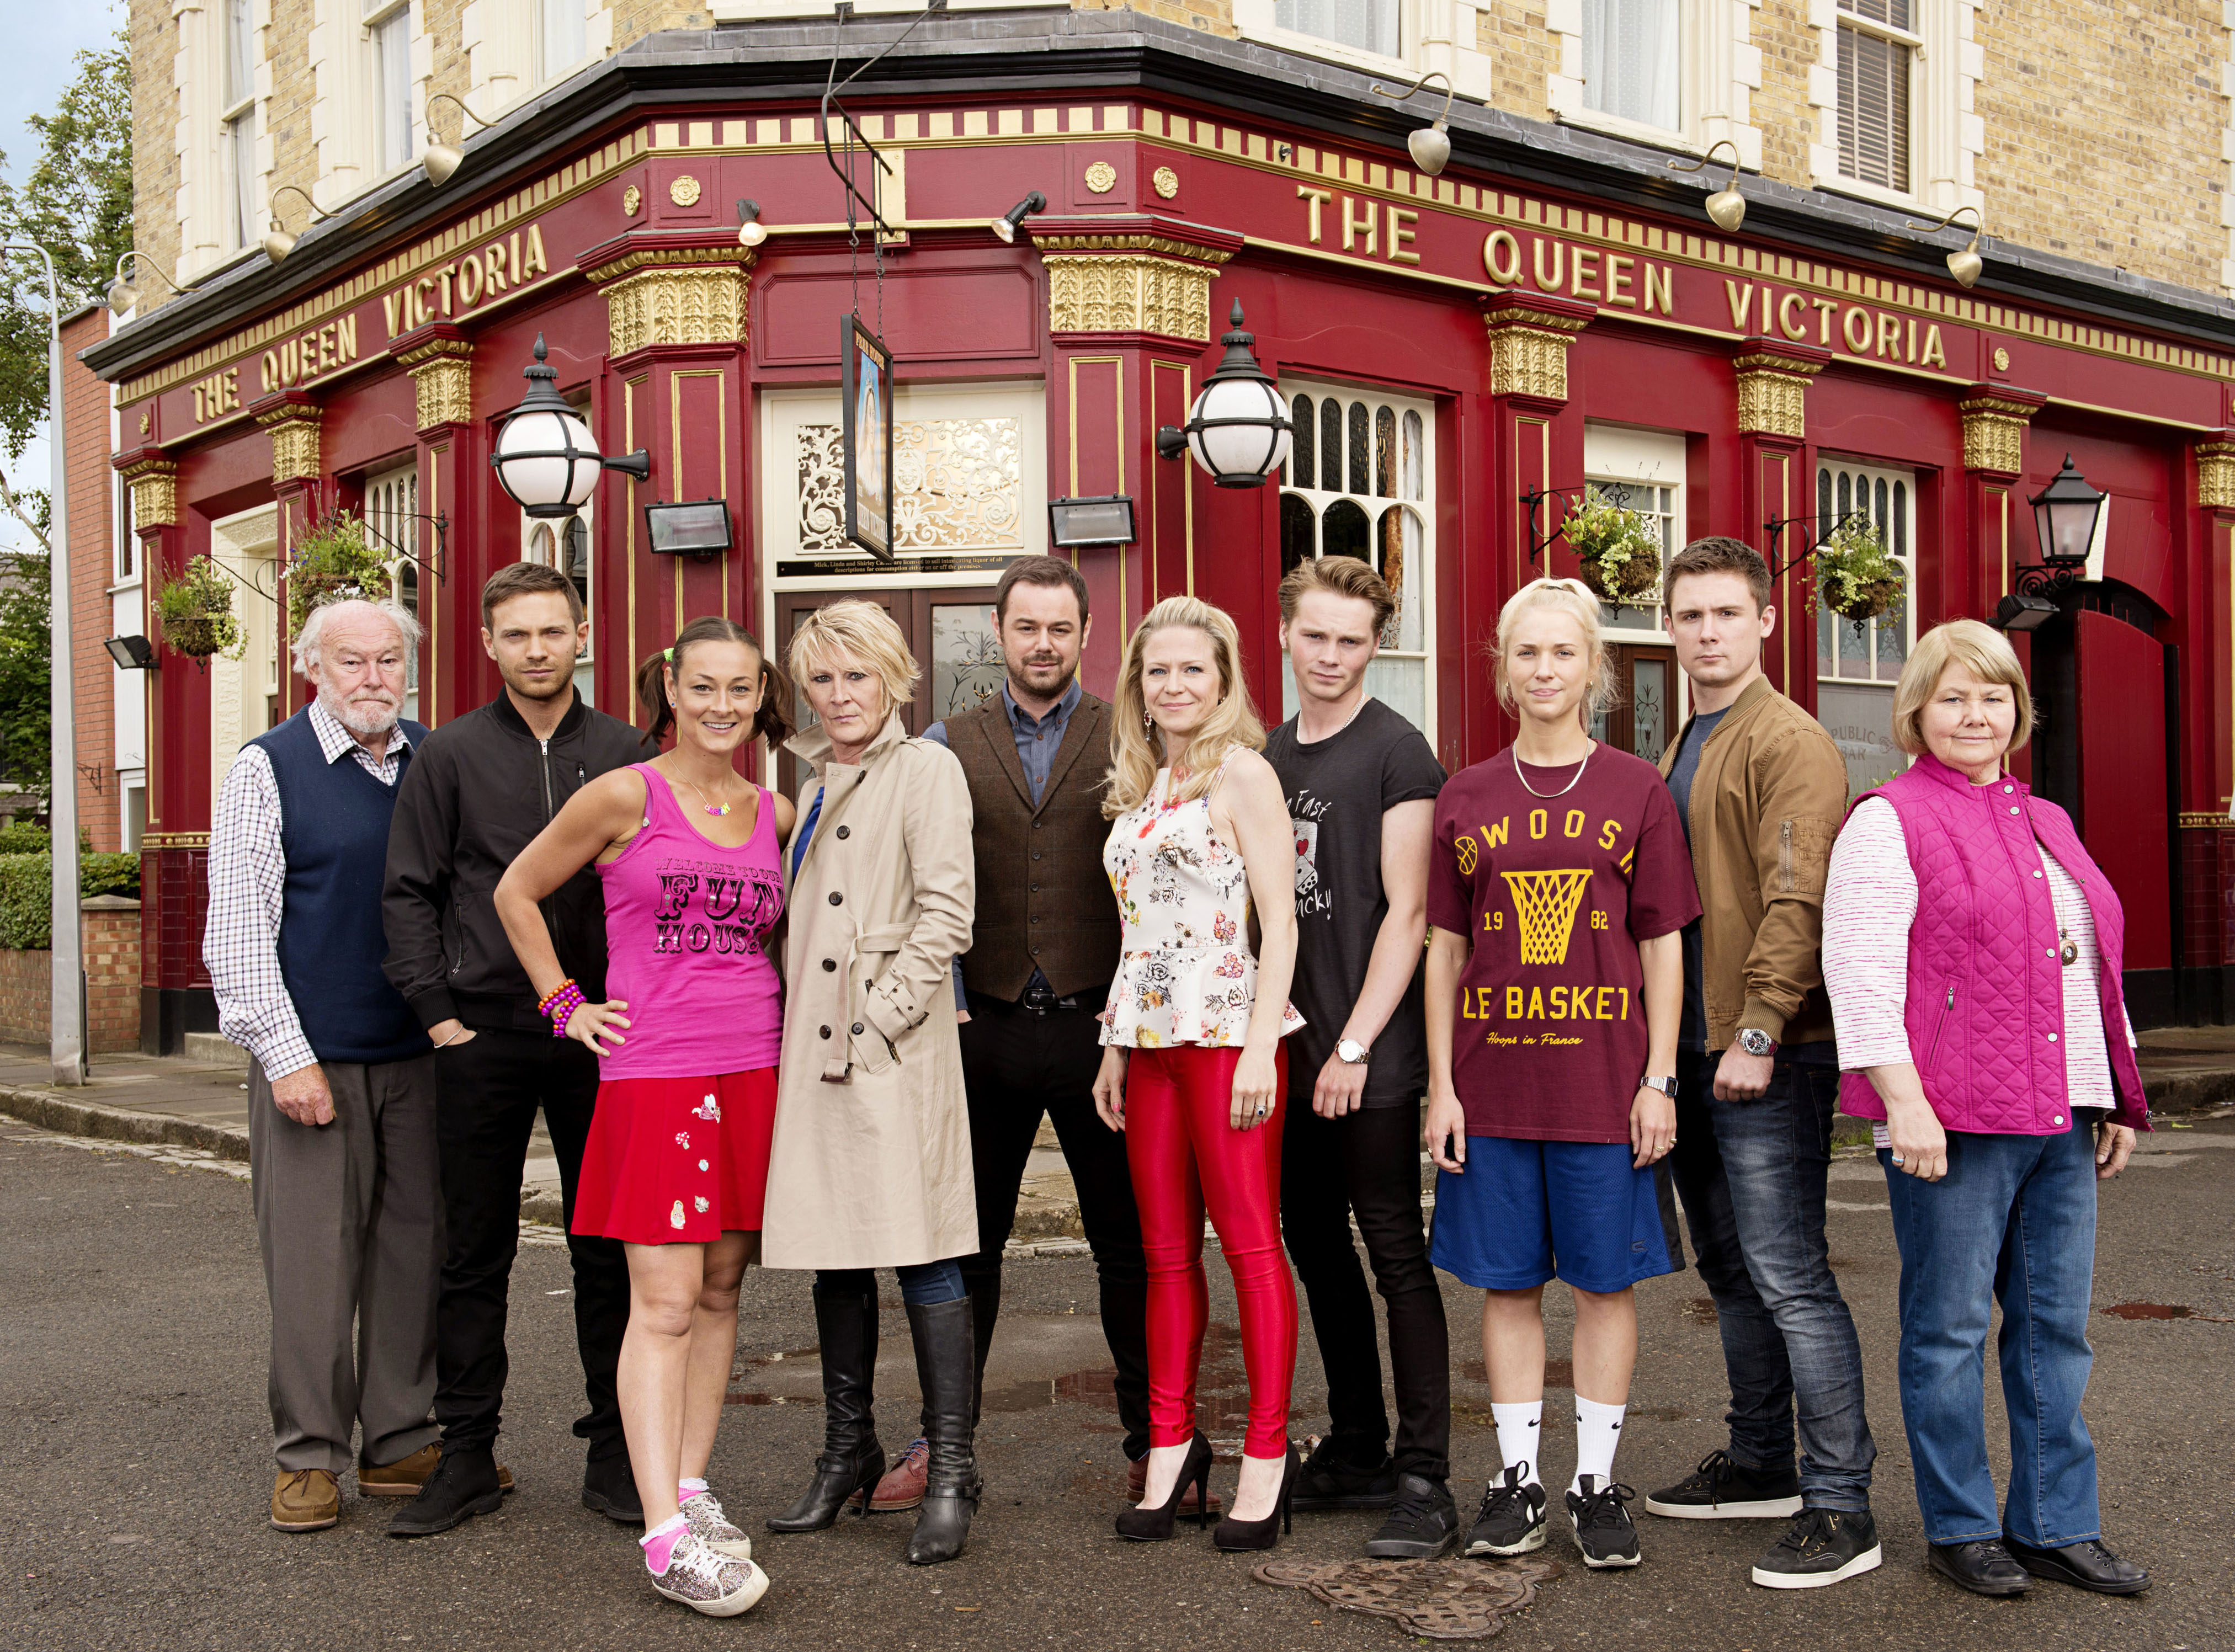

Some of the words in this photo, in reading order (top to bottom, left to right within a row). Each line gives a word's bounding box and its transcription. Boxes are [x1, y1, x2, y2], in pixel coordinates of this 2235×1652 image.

[1296, 185, 1420, 265] THE
[1483, 230, 1672, 316] QUEEN
[1725, 279, 1946, 370] VICTORIA
[190, 367, 240, 424] THE
[261, 312, 358, 395] QUEEN
[382, 224, 548, 339] VICTORIA
[1830, 725, 1876, 745] PUBLIC
[1841, 746, 1866, 761] BAR
[1295, 789, 1332, 822] Fast
[738, 866, 758, 878] TO
[654, 872, 783, 929] FUN
[1484, 912, 1503, 930] 19
[1591, 910, 1608, 929] 82
[1464, 987, 1492, 1019] LE
[1486, 1032, 1517, 1047] Hoops
[1523, 1035, 1537, 1045] in
[1541, 1033, 1583, 1046] France
